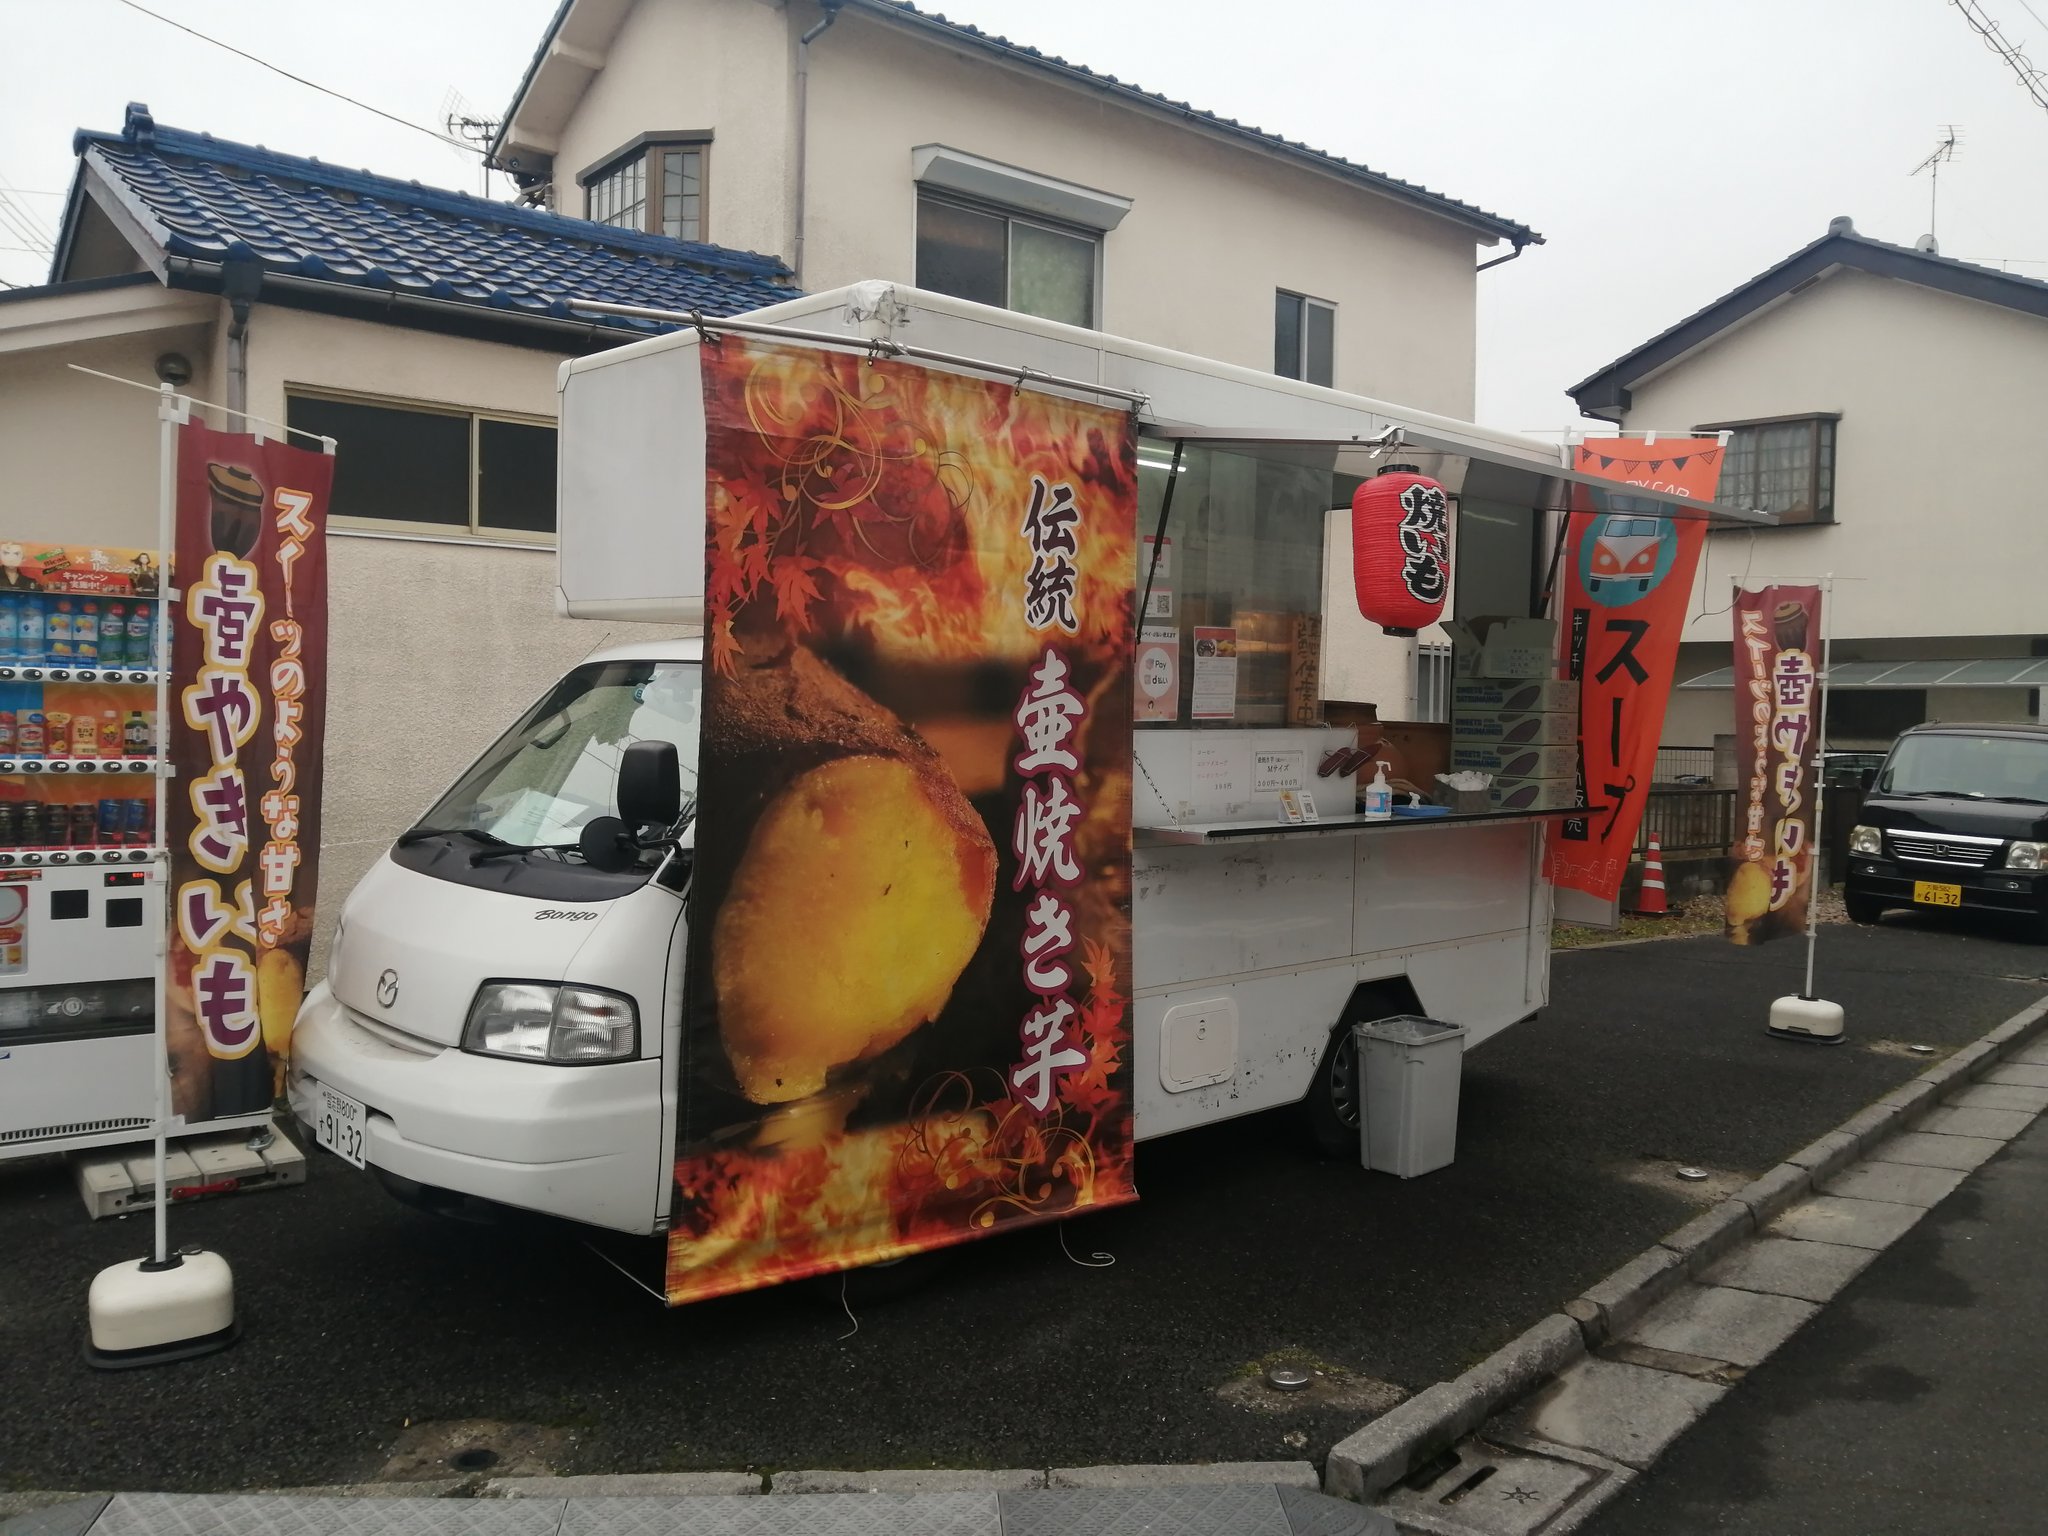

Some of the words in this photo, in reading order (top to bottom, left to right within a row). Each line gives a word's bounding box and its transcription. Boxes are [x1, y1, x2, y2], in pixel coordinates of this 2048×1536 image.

[1020, 475, 1081, 633] 伝統
[1398, 483, 1449, 604] 焼いも
[1595, 619, 1650, 843] スープ
[534, 908, 599, 921] Bongo
[1923, 891, 1958, 905] 61-32
